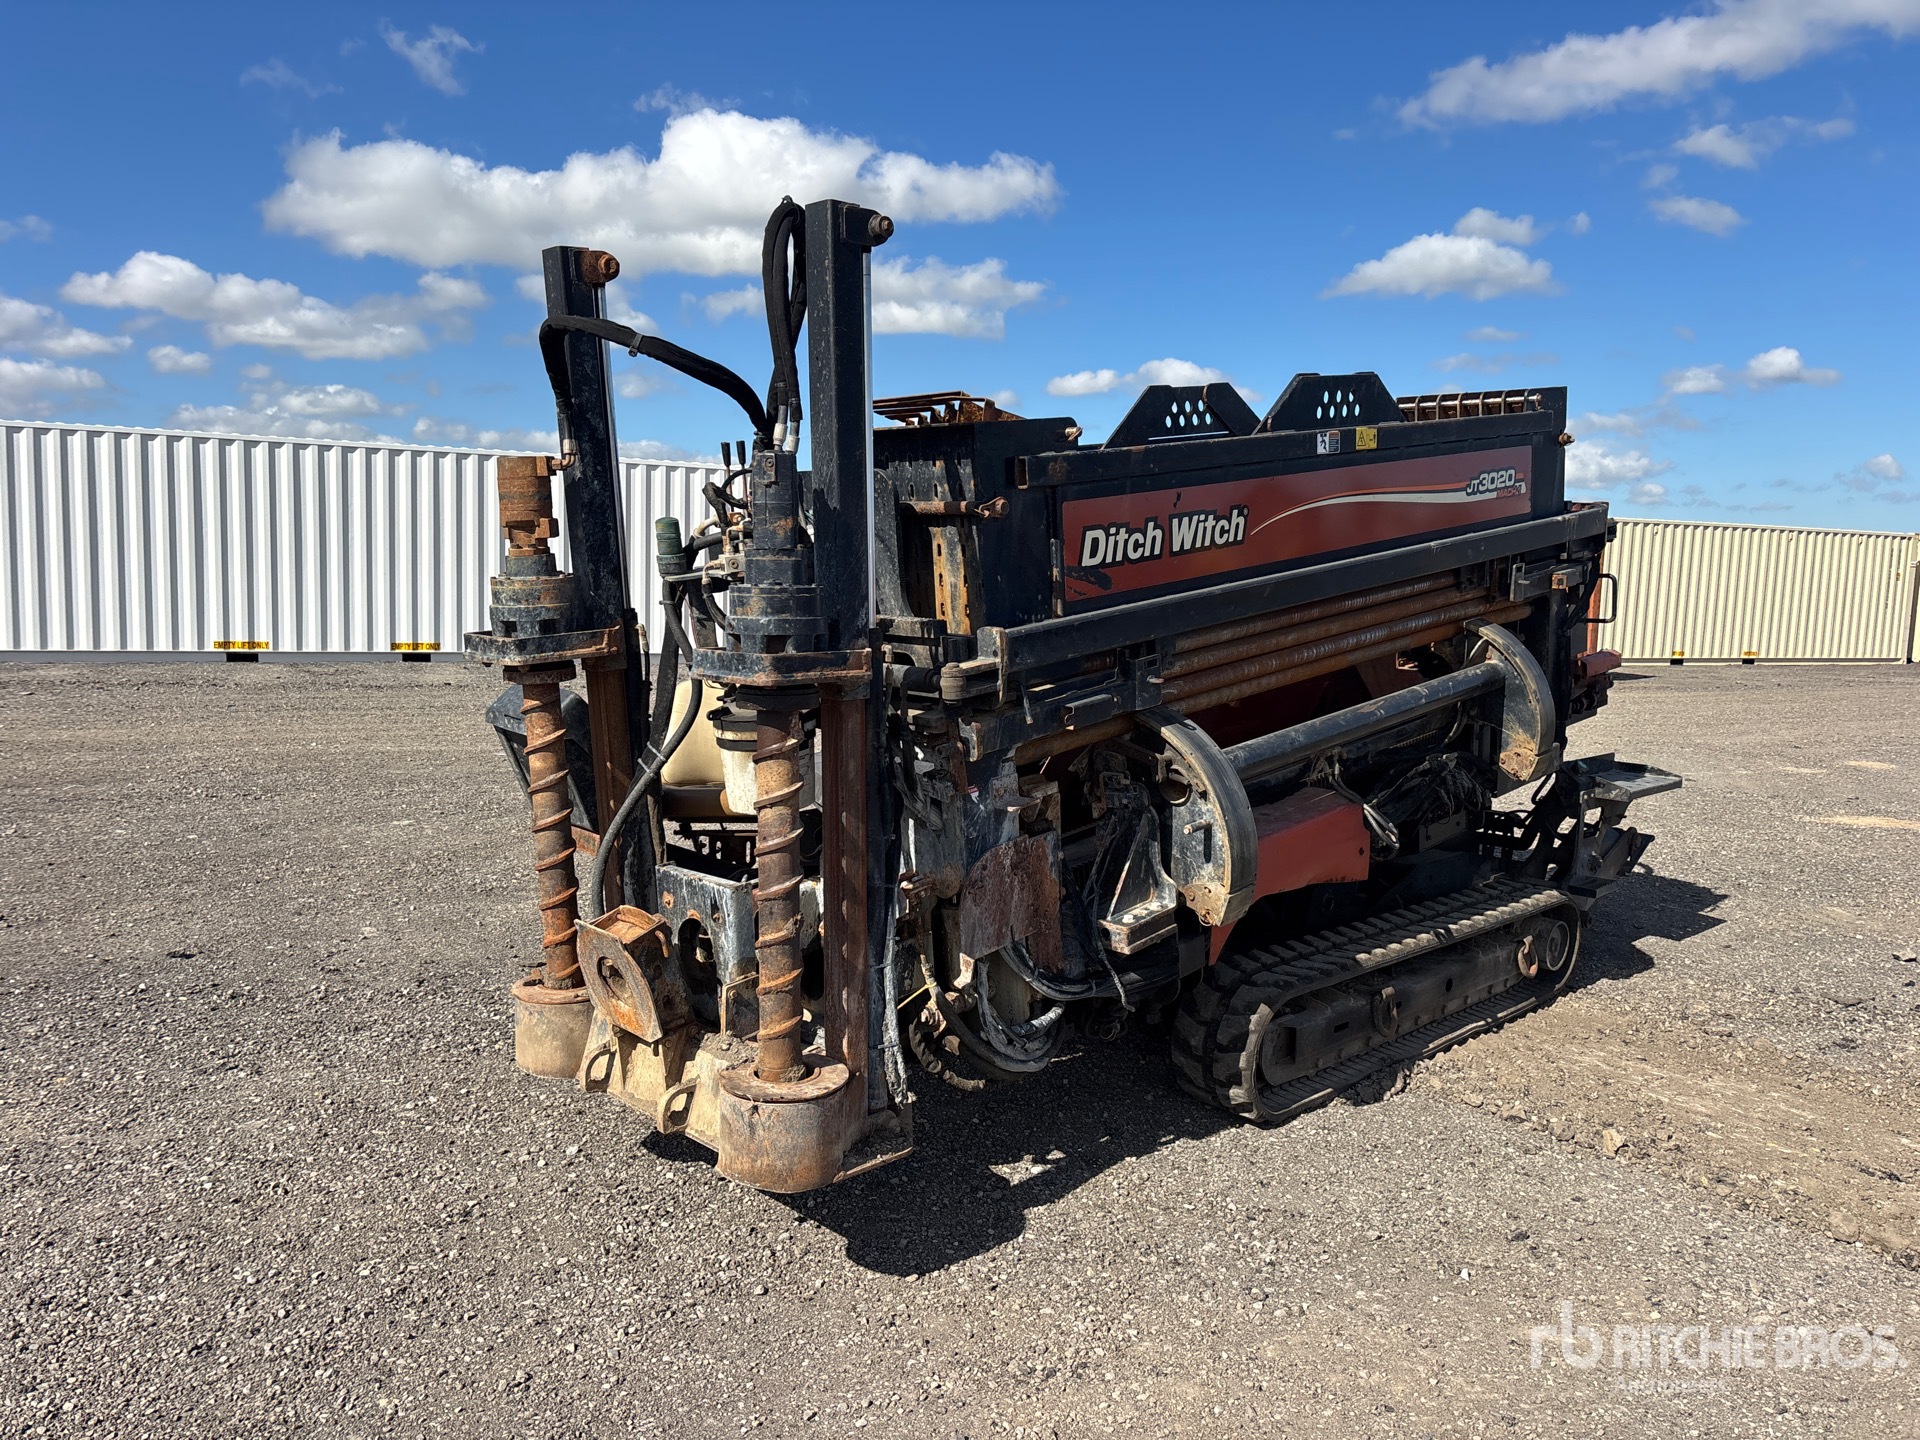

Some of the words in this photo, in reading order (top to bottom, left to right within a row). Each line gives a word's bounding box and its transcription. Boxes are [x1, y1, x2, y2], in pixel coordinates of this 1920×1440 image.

[1466, 469, 1516, 492] JT3020
[1081, 521, 1163, 567] Ditch
[1172, 509, 1246, 553] Witch
[213, 641, 236, 649] EMPTY
[237, 641, 250, 649] LIFT
[251, 641, 269, 649] ONLY
